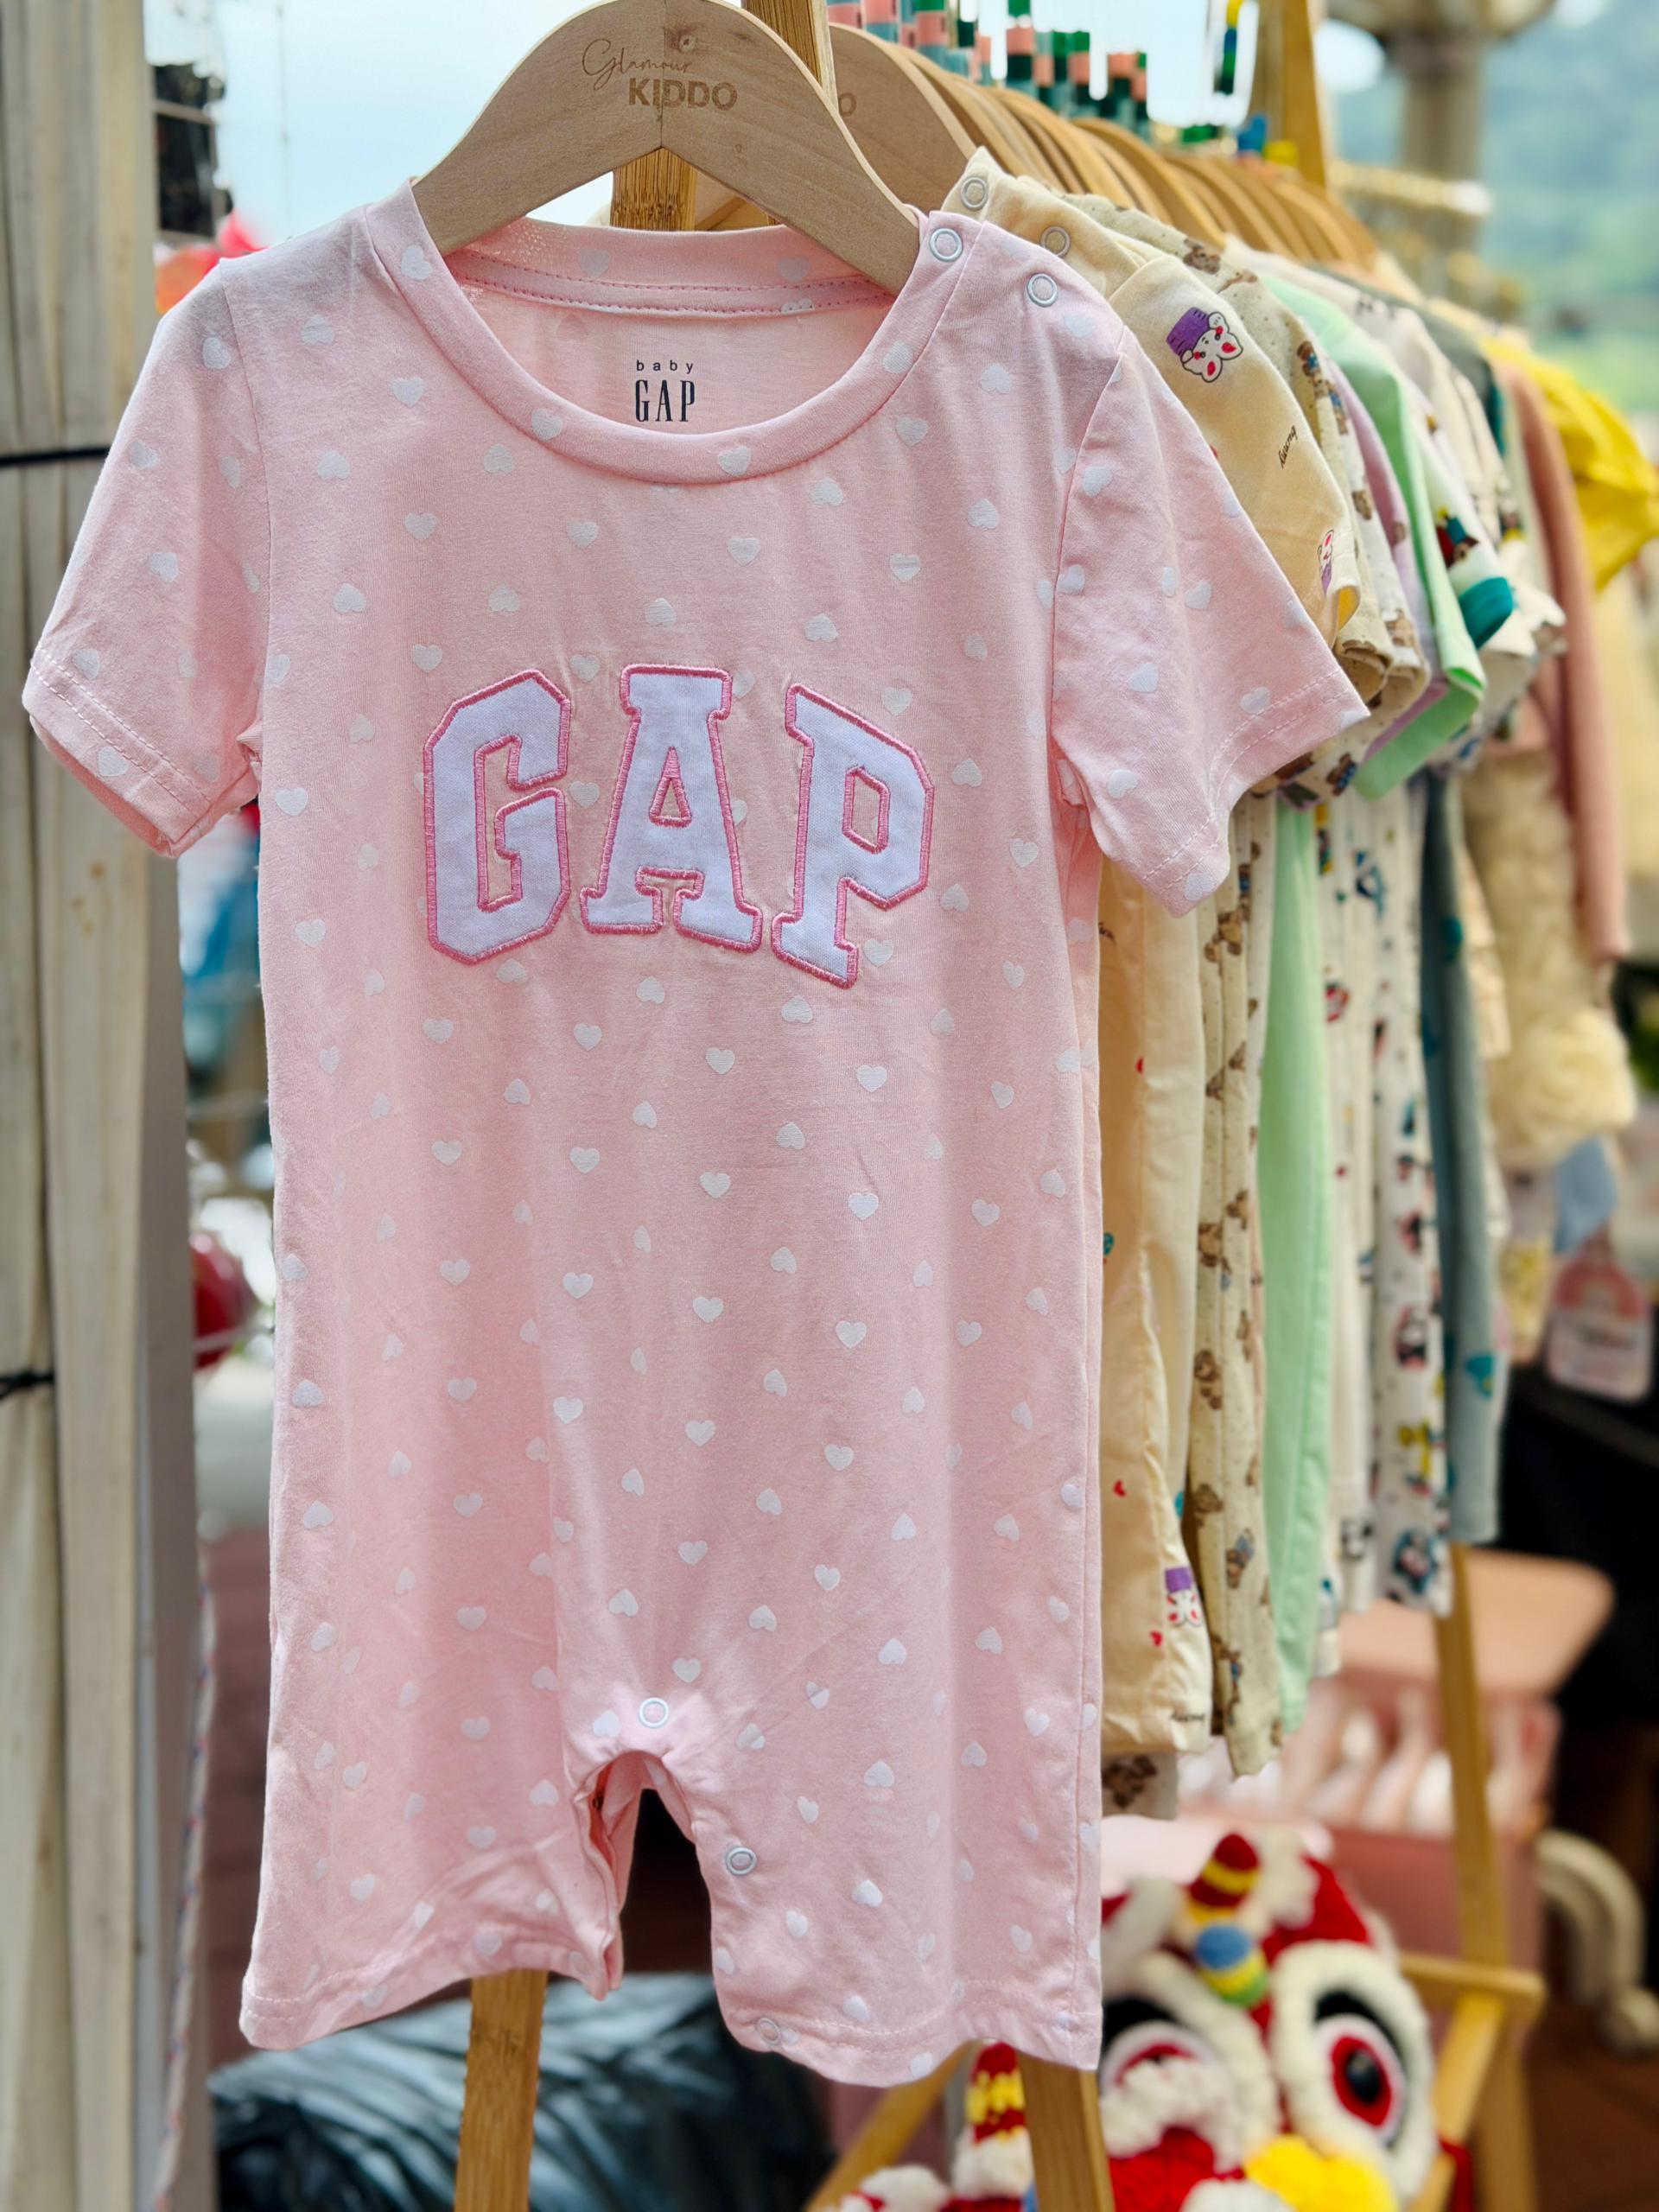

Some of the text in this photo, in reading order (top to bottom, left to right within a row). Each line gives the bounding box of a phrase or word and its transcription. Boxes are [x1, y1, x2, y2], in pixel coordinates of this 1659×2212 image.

[628, 77, 738, 111] KIDDO
[636, 359, 694, 375] baby
[635, 379, 696, 423] GAP
[423, 663, 935, 989] GAP
